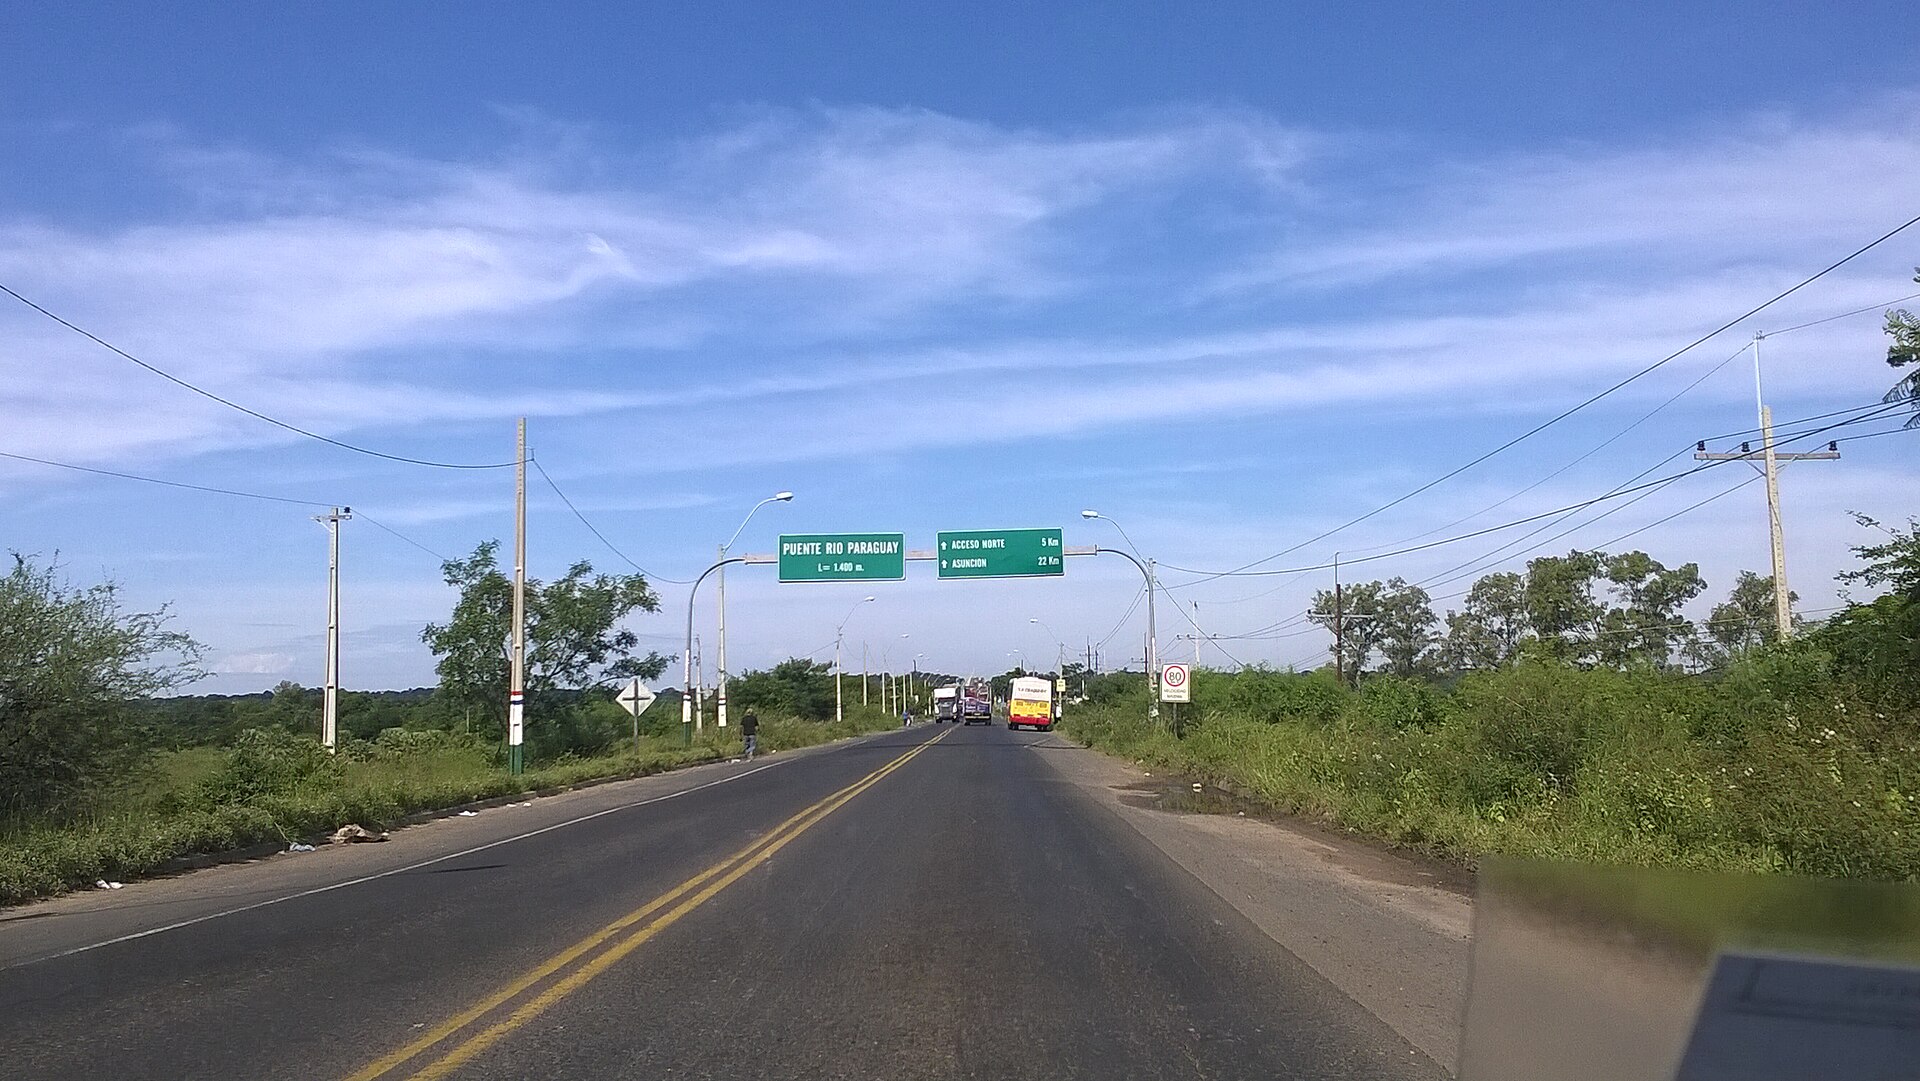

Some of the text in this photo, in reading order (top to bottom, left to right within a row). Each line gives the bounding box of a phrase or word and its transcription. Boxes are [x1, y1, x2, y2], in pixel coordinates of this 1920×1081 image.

[783, 541, 899, 555] PUENTE RIO PARAGUAY
[952, 537, 1059, 549] ACCESO NORTE 5 Km
[833, 562, 853, 572] 1.400
[952, 556, 1059, 568] ASUNCION 22 Km
[1169, 671, 1181, 681] 80
